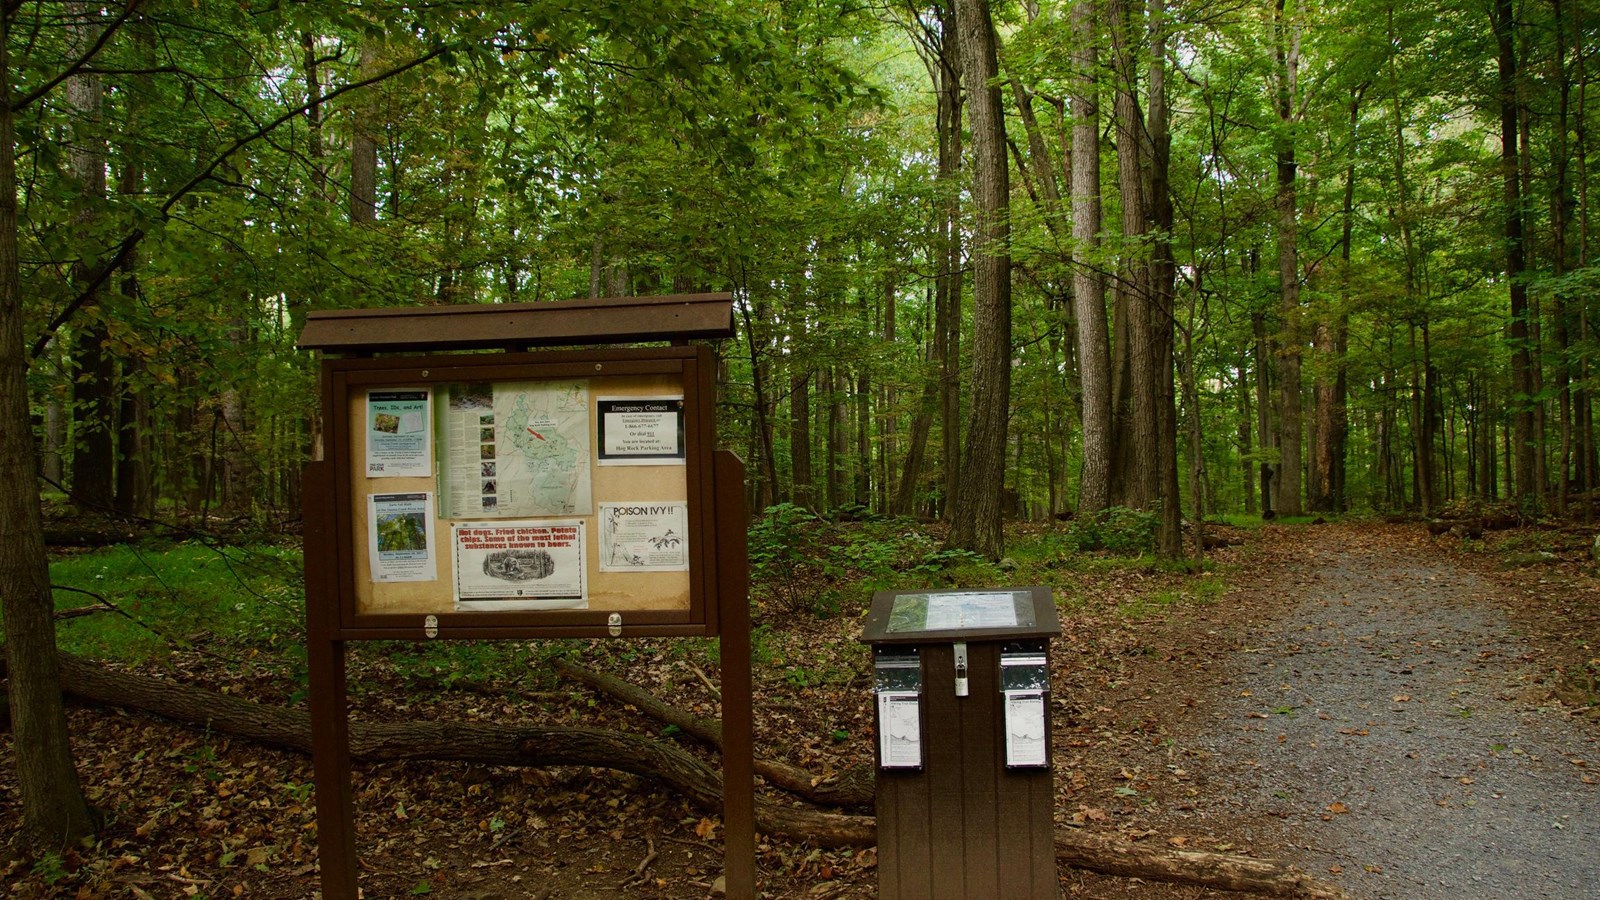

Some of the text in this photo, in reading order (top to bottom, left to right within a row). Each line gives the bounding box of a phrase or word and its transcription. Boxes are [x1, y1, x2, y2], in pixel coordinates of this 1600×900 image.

[612, 404, 644, 413] Emergency
[614, 507, 648, 515] POISON
[474, 529, 494, 537] dogs.
